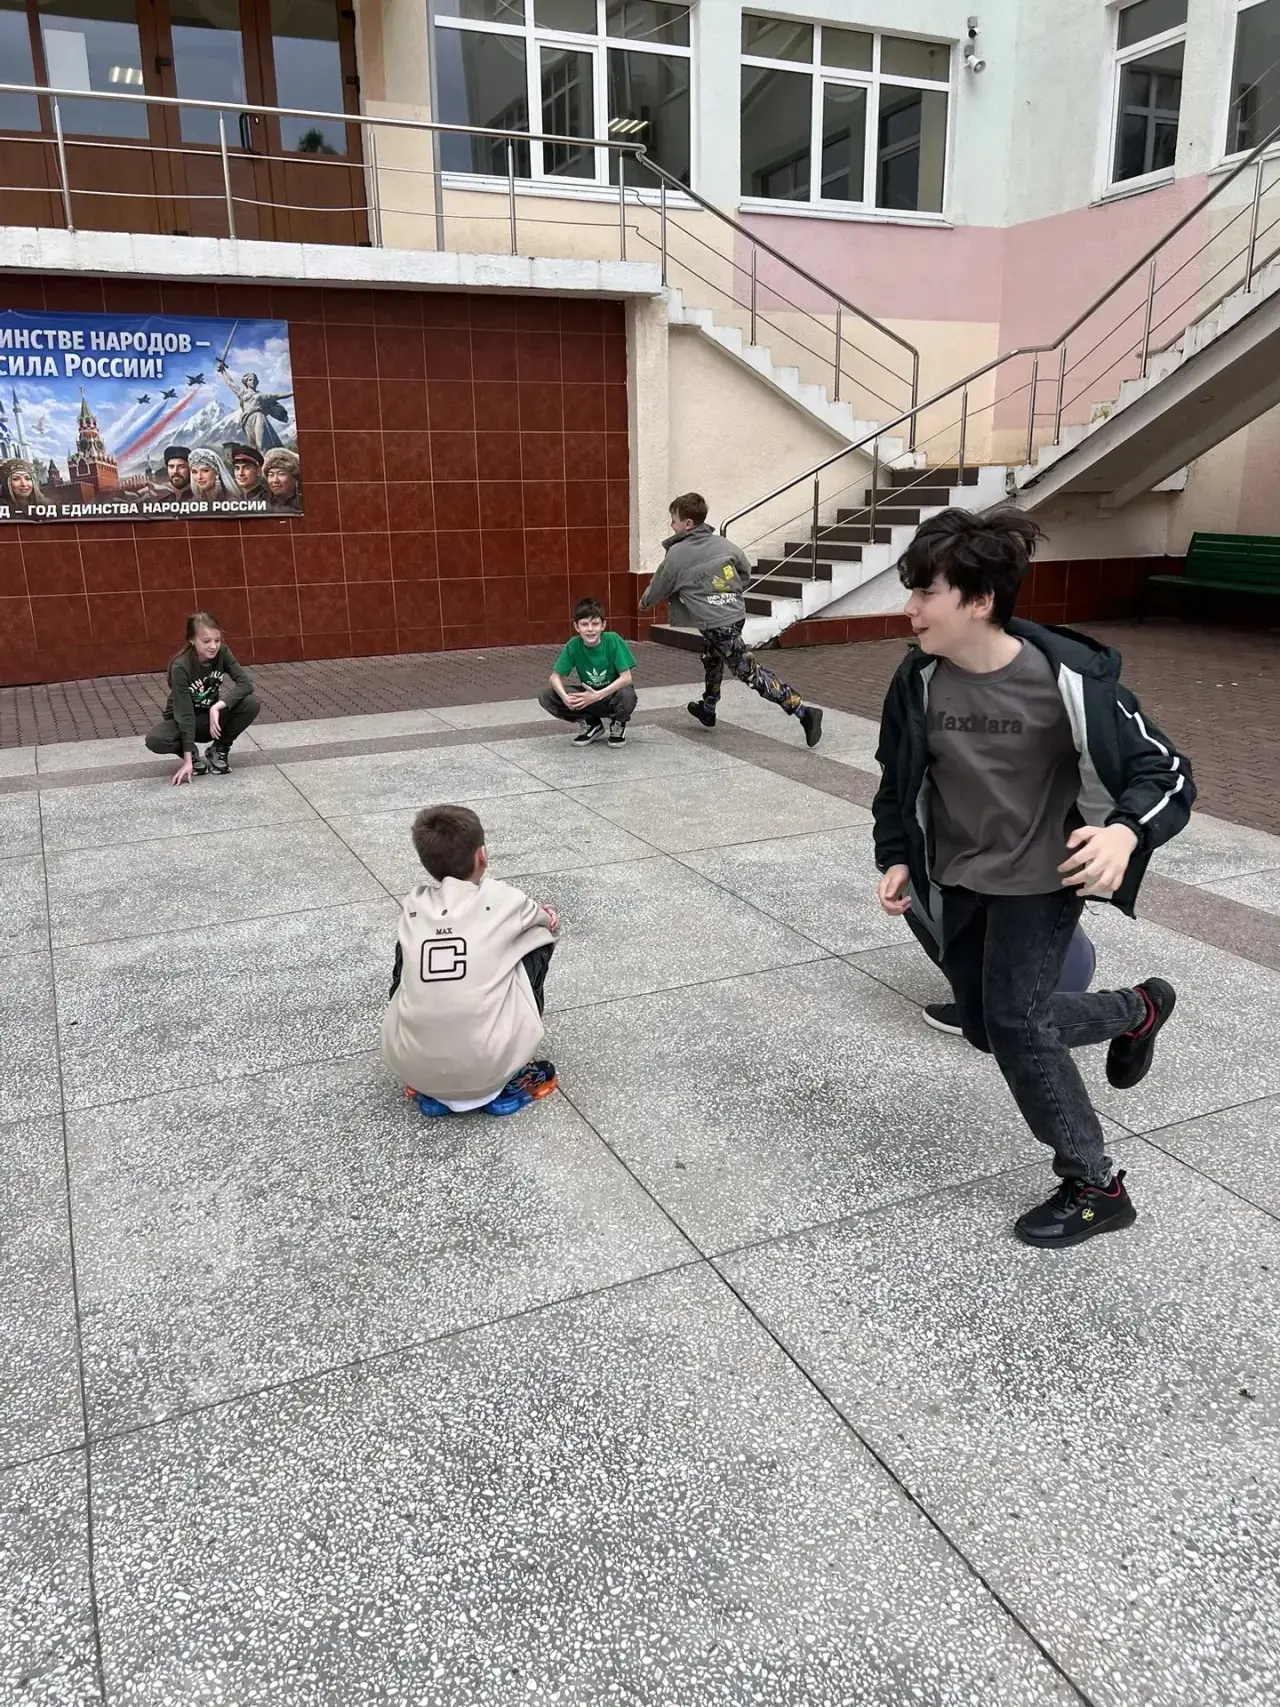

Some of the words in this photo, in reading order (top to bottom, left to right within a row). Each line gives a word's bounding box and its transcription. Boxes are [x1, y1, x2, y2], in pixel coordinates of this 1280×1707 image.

[90, 331, 192, 356] НАРОДОВ
[28, 505, 57, 518] ГОД
[62, 503, 138, 516] ЕДИНСТВА
[143, 502, 208, 514] НАРОДОВ
[213, 501, 266, 512] РОССИИ
[435, 927, 453, 935] MAX
